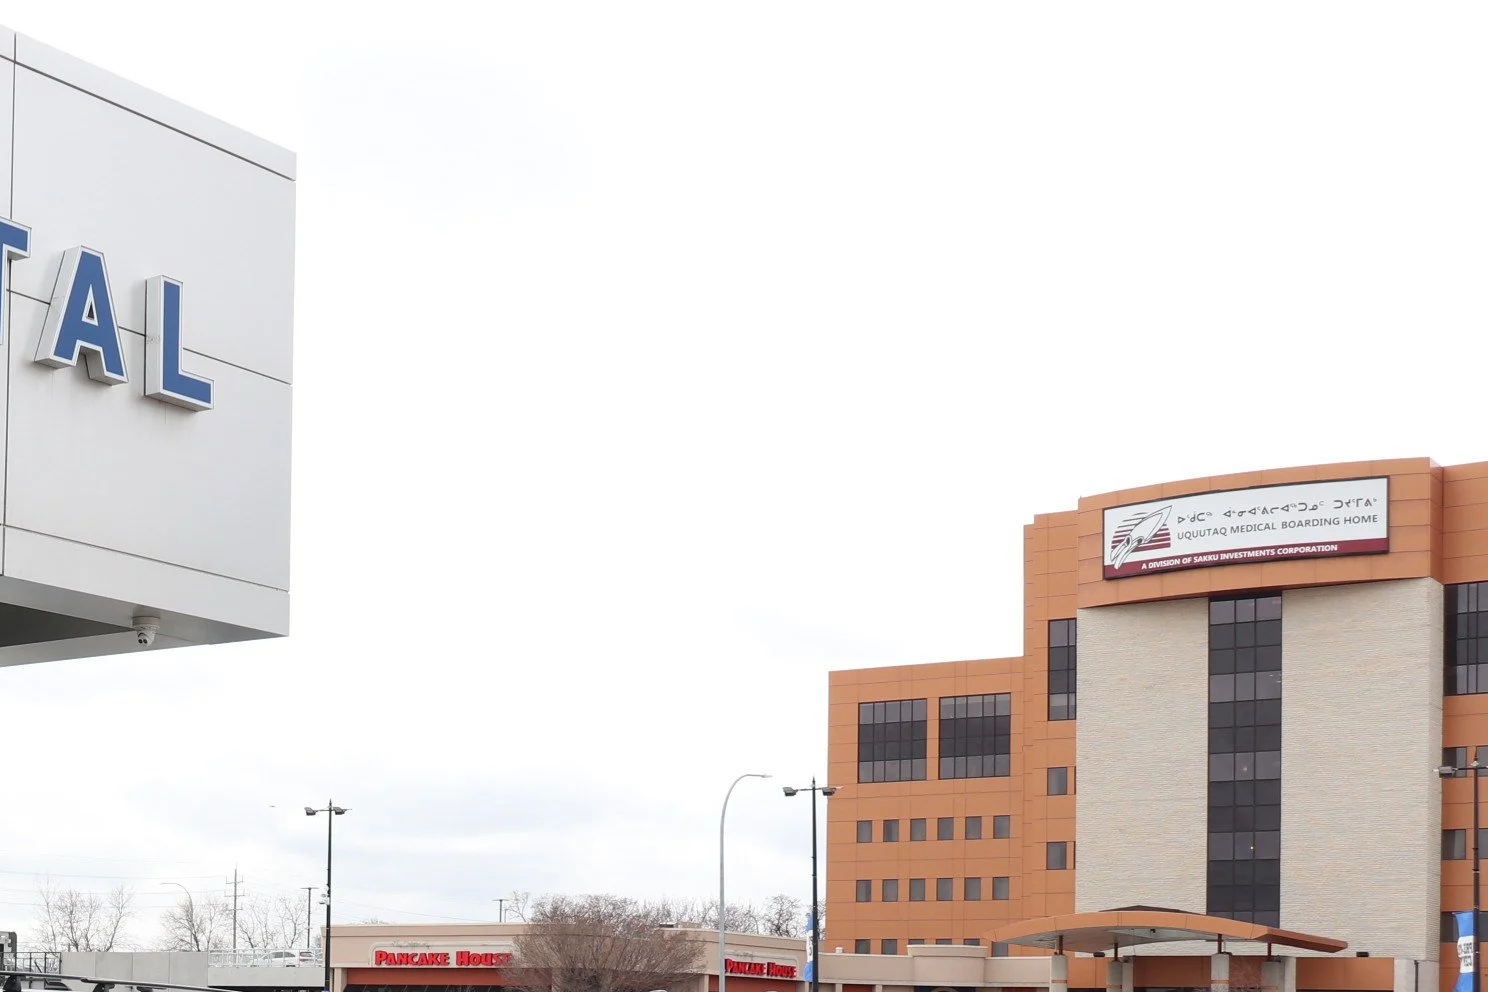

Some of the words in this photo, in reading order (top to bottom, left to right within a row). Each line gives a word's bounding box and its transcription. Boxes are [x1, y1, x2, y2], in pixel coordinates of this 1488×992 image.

[1177, 526, 1227, 541] UQUUTAQ
[1230, 522, 1277, 534] MEDICAL
[1281, 517, 1341, 530] BOARDING
[1343, 514, 1379, 525] HOME
[1141, 562, 1148, 570] A
[1148, 557, 1181, 569] DIVISION
[1181, 556, 1192, 565] OF
[1193, 554, 1219, 563] SAKKU
[1220, 548, 1276, 560] INVESTMENTS
[1277, 544, 1338, 555] CORPORATION
[374, 950, 450, 966] PANCAKE
[725, 958, 766, 976] PANCAKE
[767, 961, 797, 979] HOUSE
